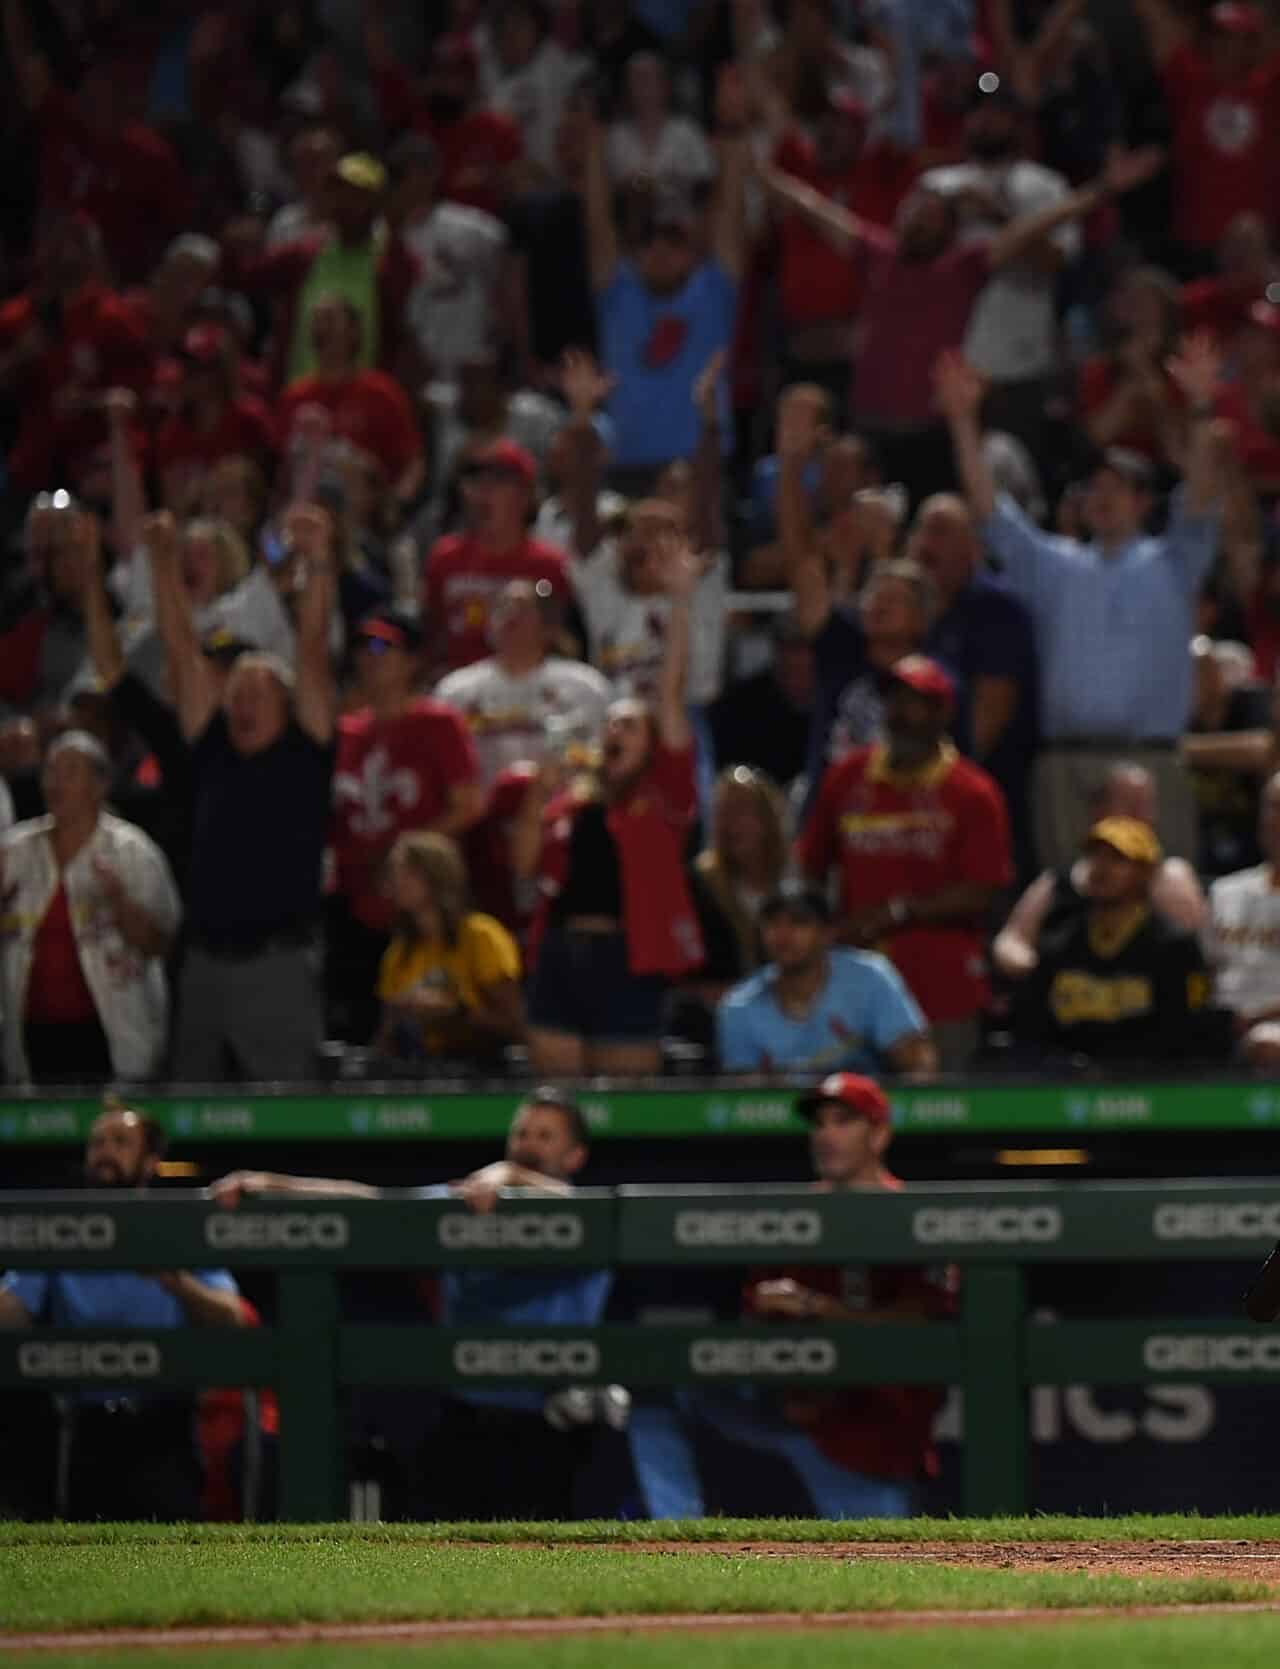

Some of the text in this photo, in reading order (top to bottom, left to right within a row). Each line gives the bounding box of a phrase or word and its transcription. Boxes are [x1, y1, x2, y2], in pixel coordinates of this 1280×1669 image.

[0, 1213, 116, 1249] EICO
[204, 1213, 349, 1249] GEICO
[438, 1212, 584, 1249] GEICO
[674, 1209, 823, 1245] GEICO
[912, 1206, 1062, 1243] GEICO
[18, 1341, 161, 1377] GEICO
[454, 1340, 600, 1375] GEICO
[690, 1339, 837, 1374] GEICO
